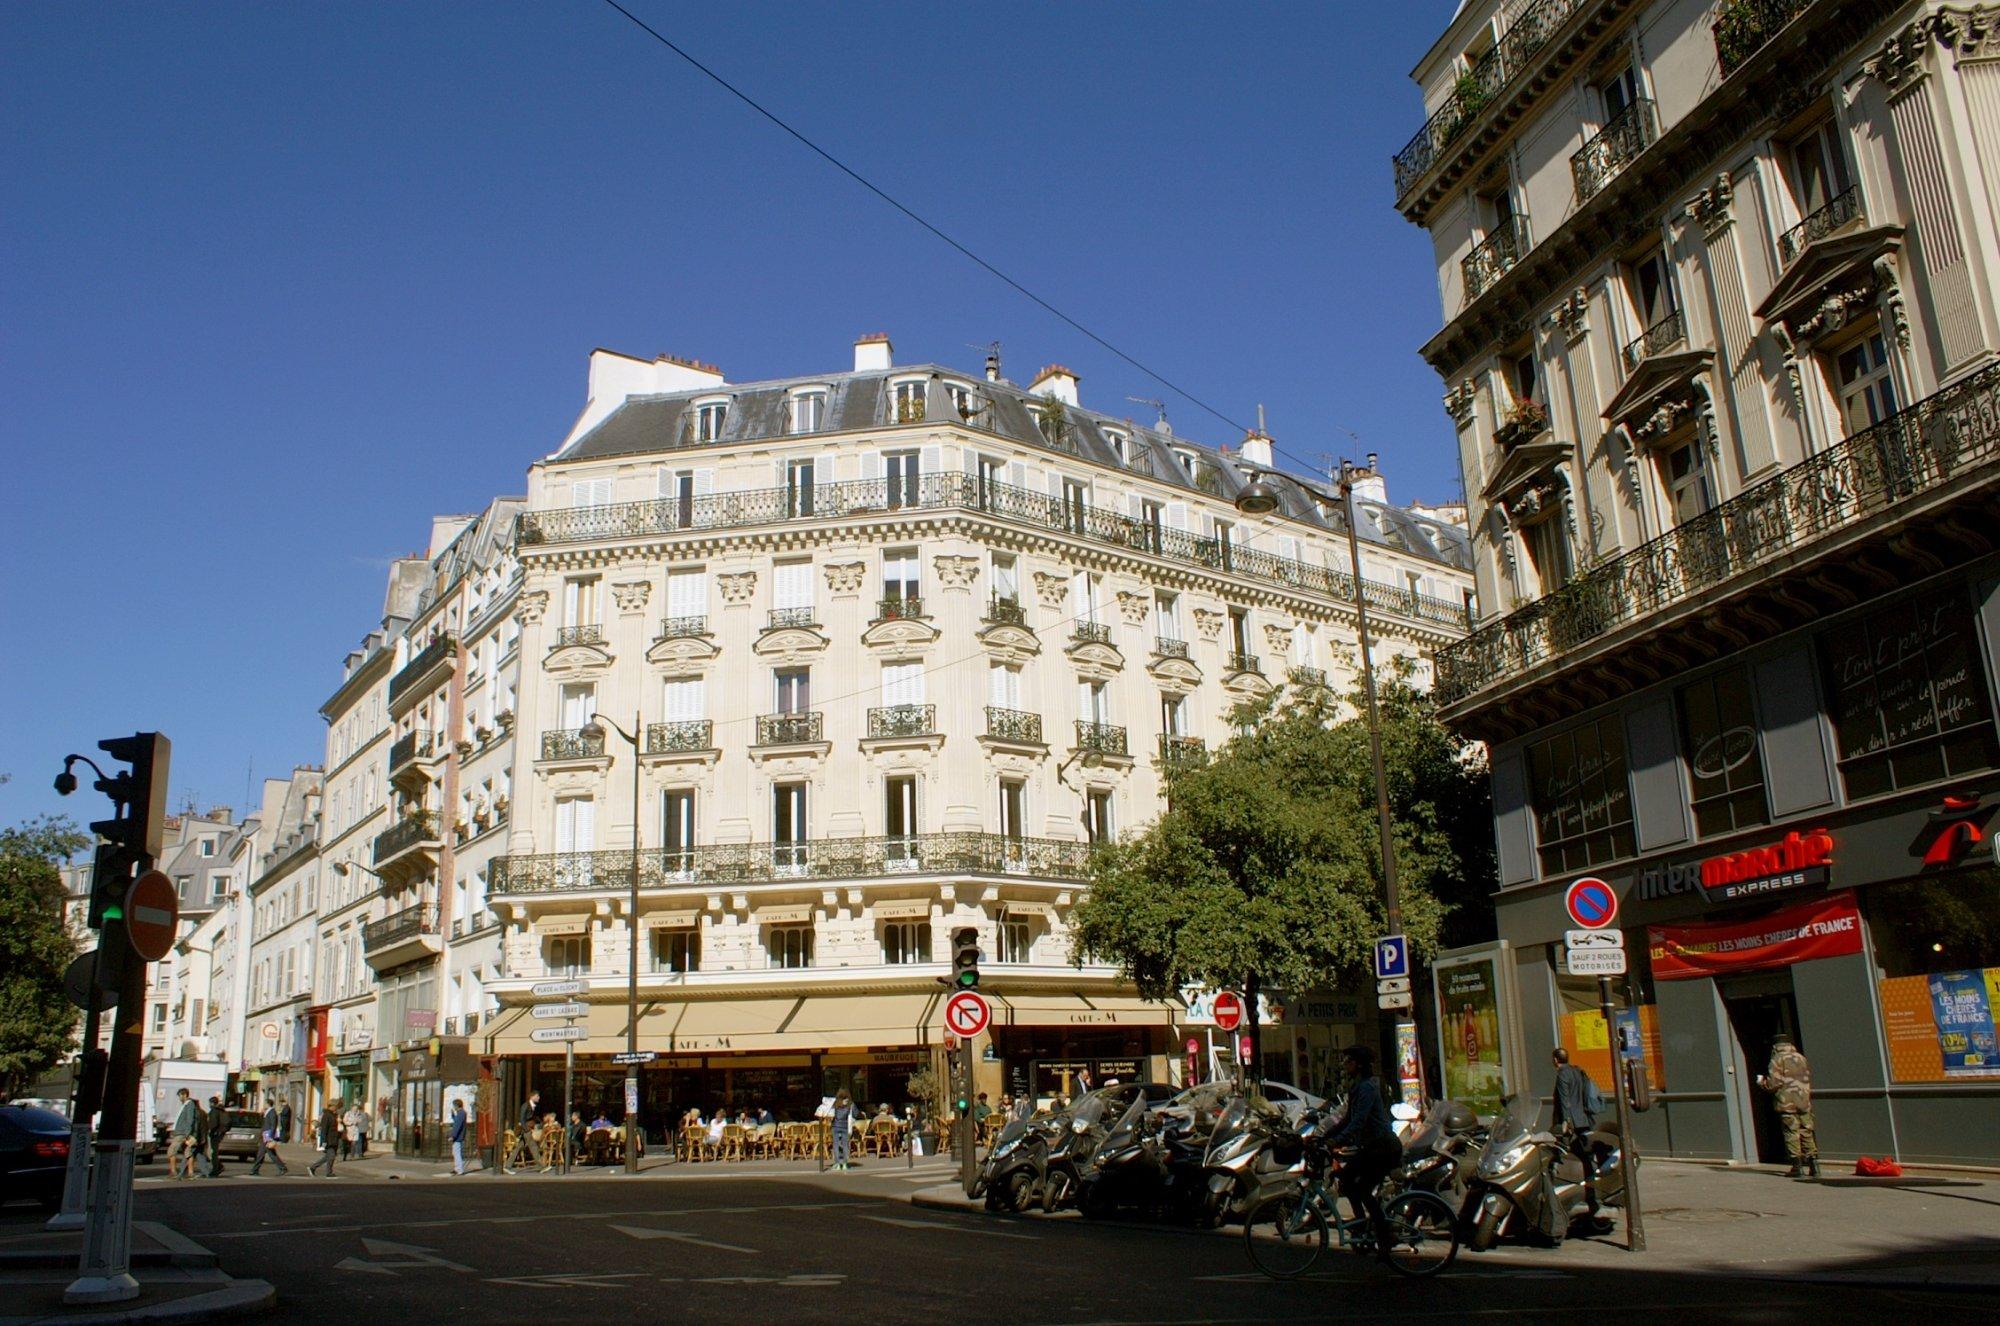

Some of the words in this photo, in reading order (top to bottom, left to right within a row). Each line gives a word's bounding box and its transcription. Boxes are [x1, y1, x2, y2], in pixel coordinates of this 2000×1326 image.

[1726, 873, 1805, 897] EXPRESS
[1718, 938, 1735, 951] LES
[1735, 935, 1763, 950] MOINS
[1799, 924, 1812, 938] DE
[1571, 953, 1590, 962] SAUF
[1591, 953, 1597, 961] 2
[1597, 952, 1622, 961] ROUES
[1939, 996, 1954, 1006] LES
[1954, 993, 1981, 1004] MOINS
[1189, 1002, 1204, 1017] LA
[1105, 1012, 1116, 1023] M
[540, 1029, 577, 1038] MONTMARTRE
[716, 1037, 731, 1049] M
[874, 1053, 915, 1062] MAUBEUGE
